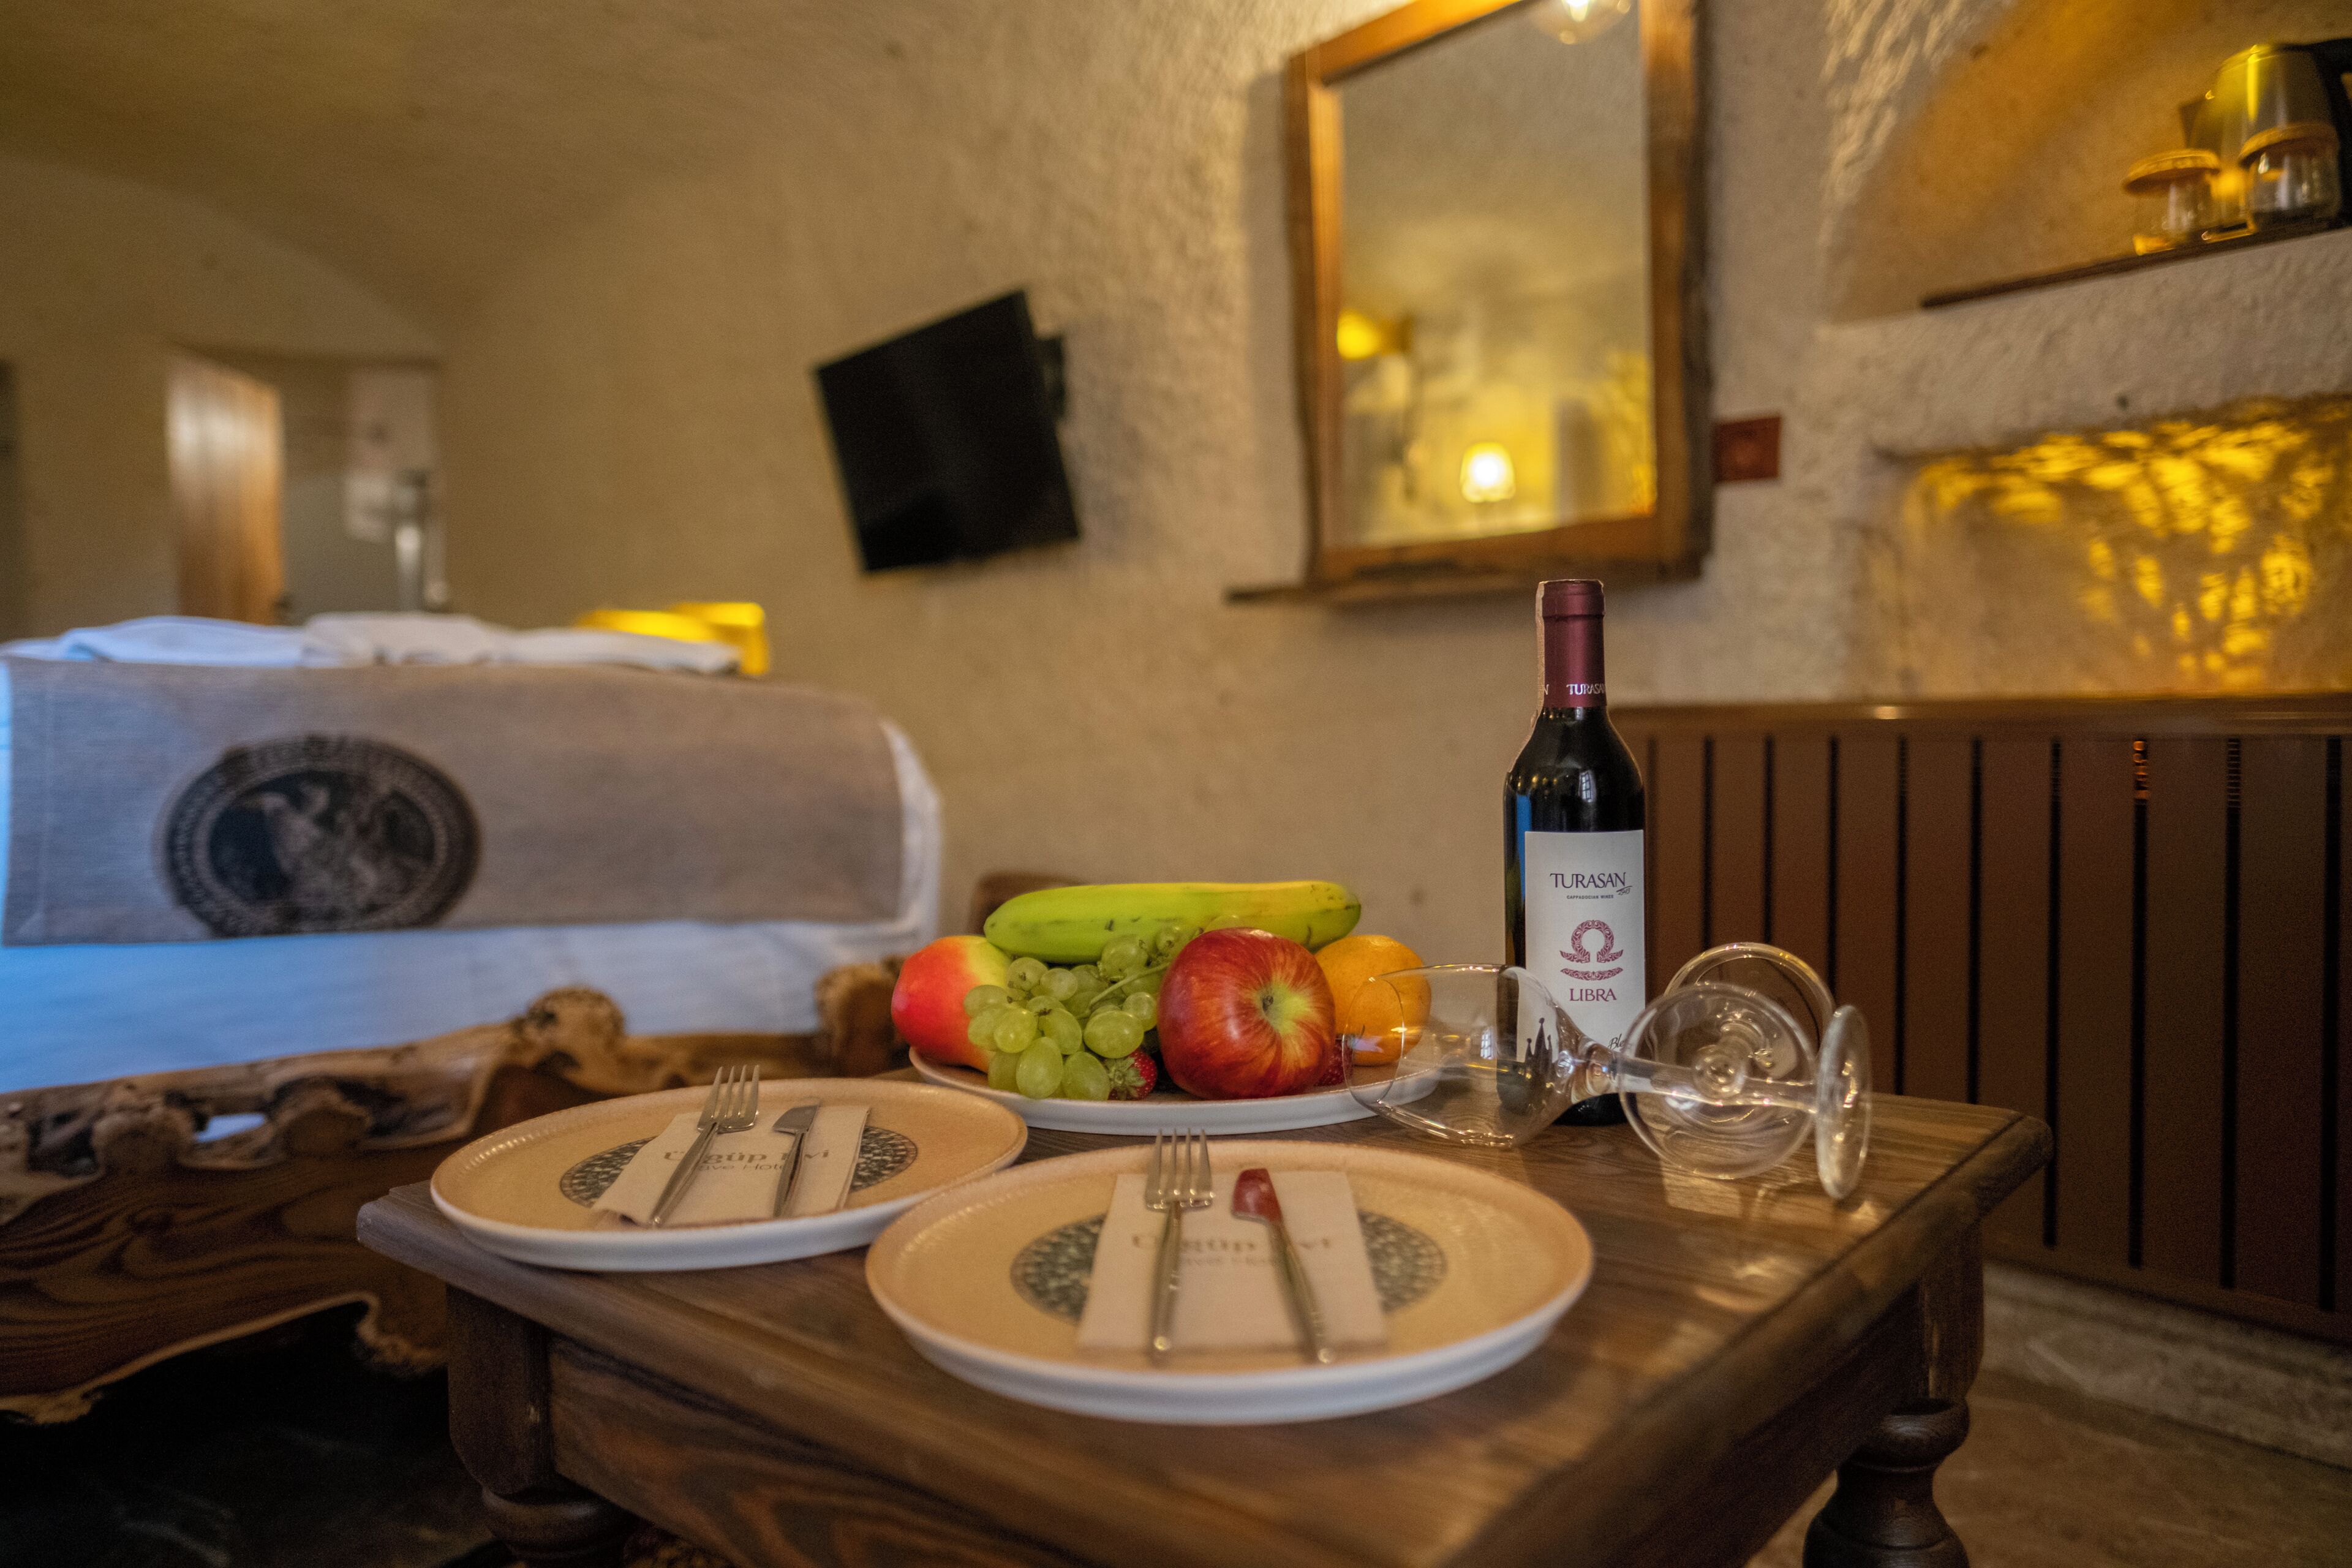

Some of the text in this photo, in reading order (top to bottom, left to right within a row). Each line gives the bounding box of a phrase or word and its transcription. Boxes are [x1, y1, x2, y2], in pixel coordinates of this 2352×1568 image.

[1550, 872, 1626, 889] TURASAN
[1569, 988, 1617, 1001] LIBRA
[664, 1152, 767, 1165] Ügüp
